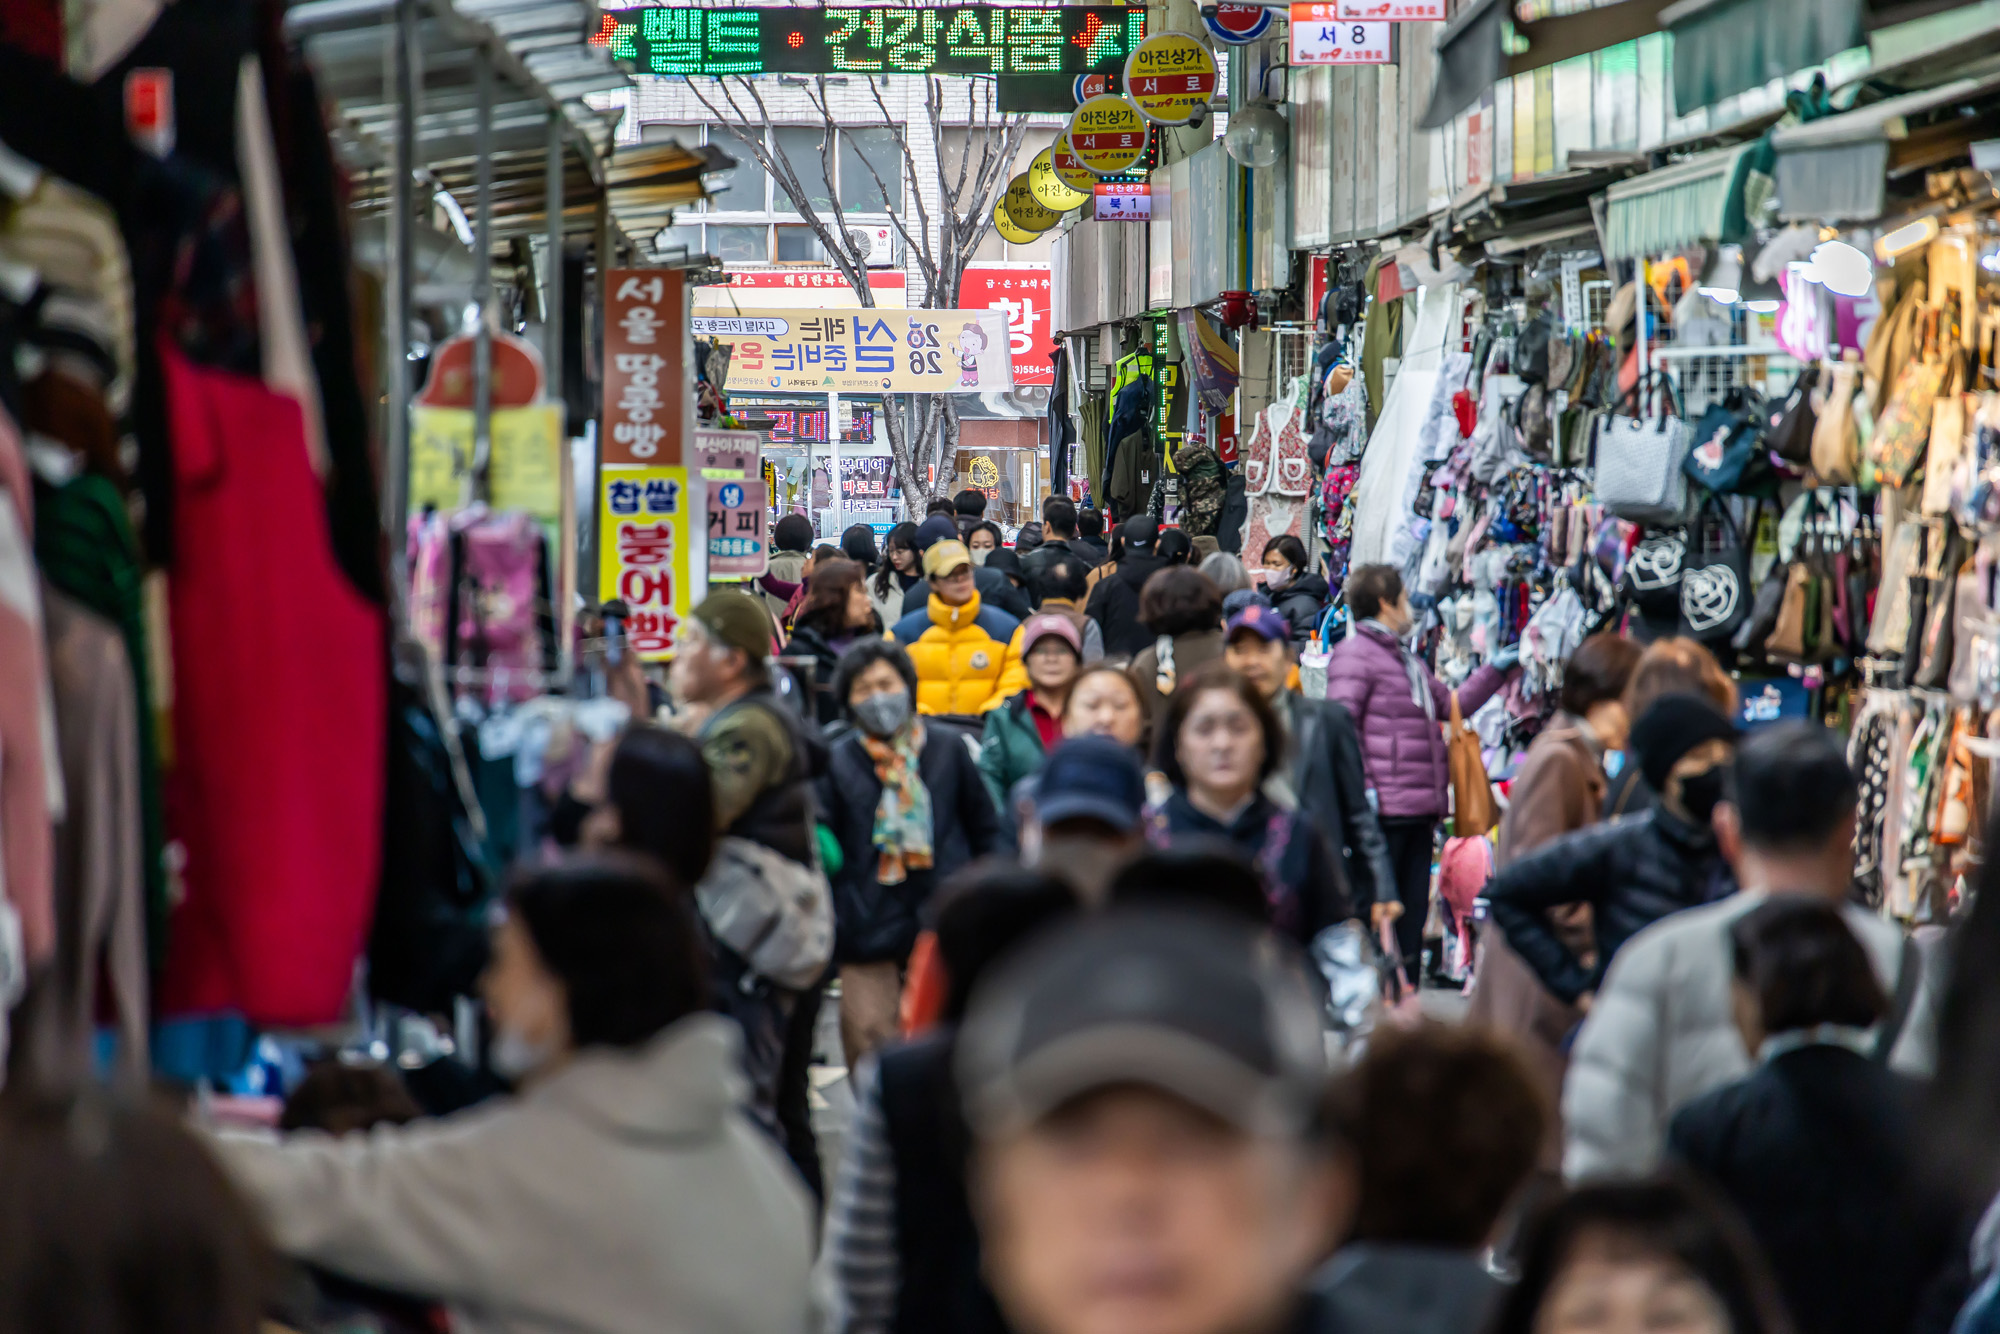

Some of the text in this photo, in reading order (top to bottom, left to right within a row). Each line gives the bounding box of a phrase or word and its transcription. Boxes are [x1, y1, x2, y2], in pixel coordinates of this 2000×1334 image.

[1219, 3, 1257, 13] 소화
[643, 8, 763, 73] 벨트
[824, 8, 1063, 72] 건강식품
[1319, 25, 1365, 44] 서 8
[1139, 47, 1202, 66] 아진상가
[1081, 109, 1134, 125] 아진상가
[1037, 183, 1087, 198] 아진상
[1105, 184, 1144, 193] 아진상가
[1110, 197, 1137, 210] 북 1
[616, 277, 667, 345] 서울
[989, 297, 1041, 355] 황
[609, 480, 679, 515] 찹쌀
[620, 524, 679, 651] 붕어빵
